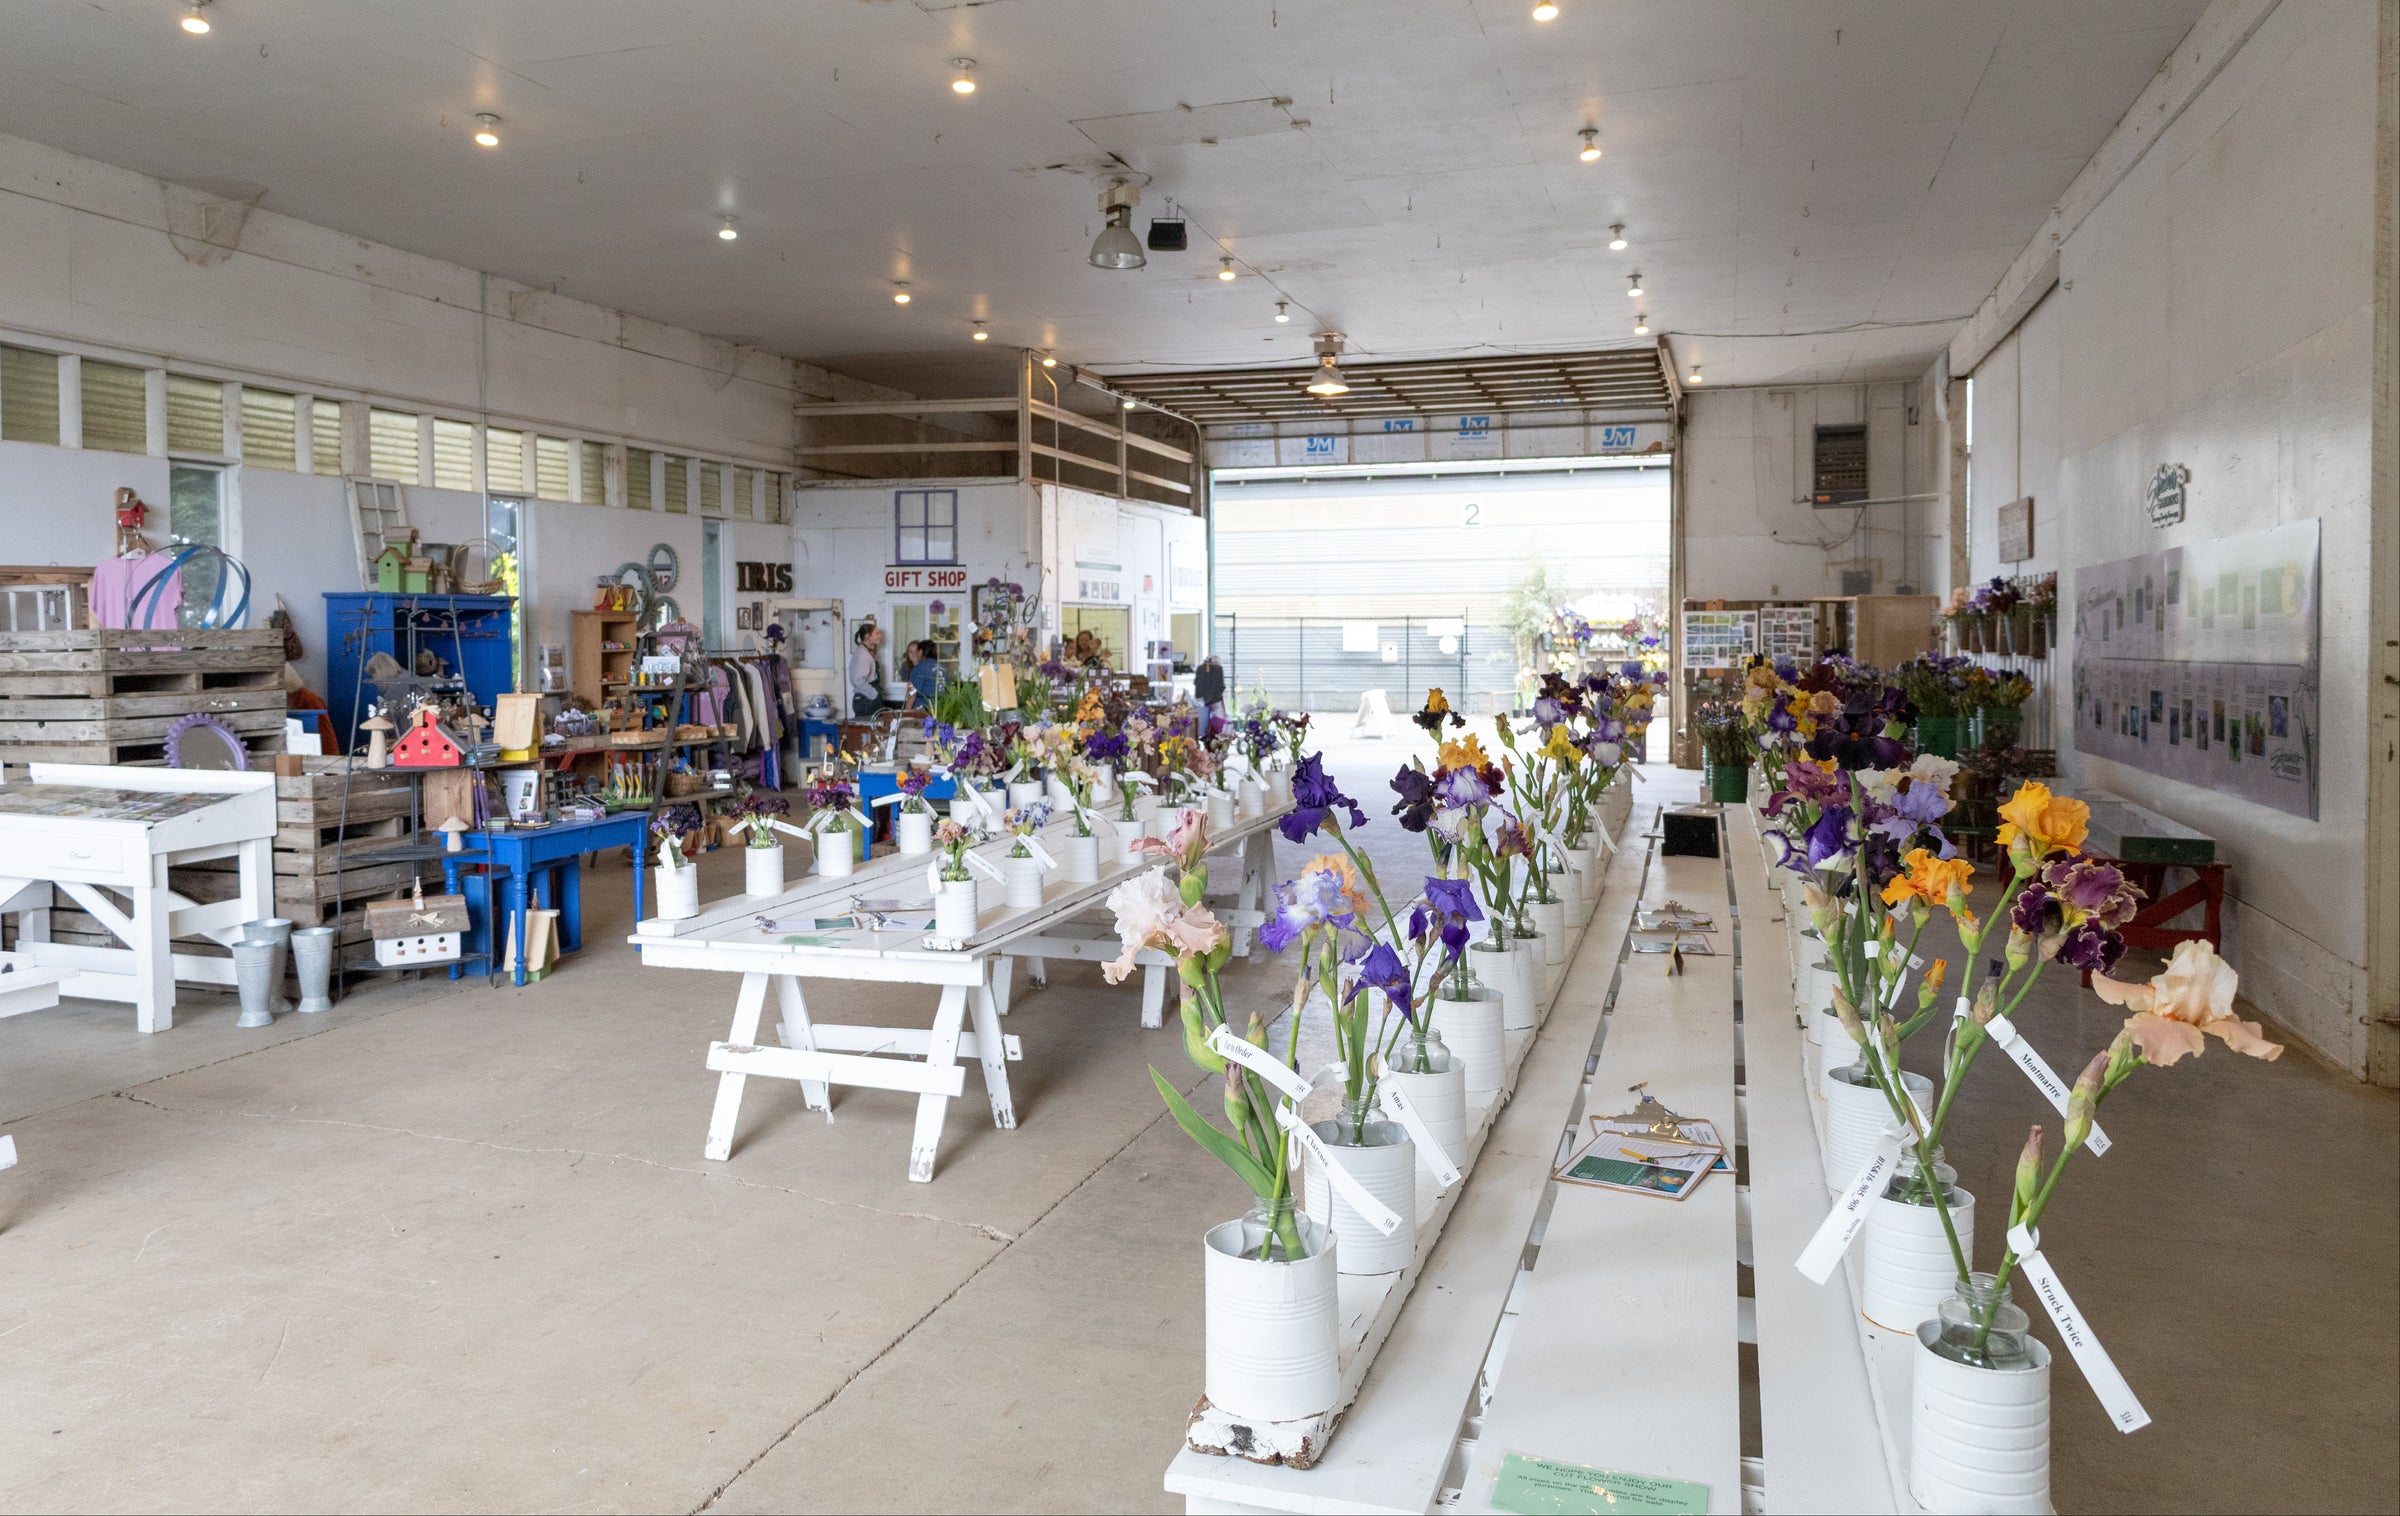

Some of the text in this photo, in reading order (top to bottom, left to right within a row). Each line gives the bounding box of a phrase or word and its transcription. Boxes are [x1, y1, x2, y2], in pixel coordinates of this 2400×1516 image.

[1602, 428, 1636, 446] JM
[1464, 503, 1480, 525] 2
[736, 561, 793, 593] IRIS
[885, 571, 967, 588] GIFT SHOP
[2020, 1053, 2061, 1099] Montmartre
[1391, 1091, 1405, 1111] Amas
[1306, 1134, 1329, 1168] Clarence
[2038, 1276, 2083, 1348] Struck Twice
[1536, 1462, 1673, 1489] WE HOPE YOU ENJOY OUR
[1553, 1471, 1657, 1492] CUT FLOWER SHOW
[1658, 1496, 1689, 1507] display
